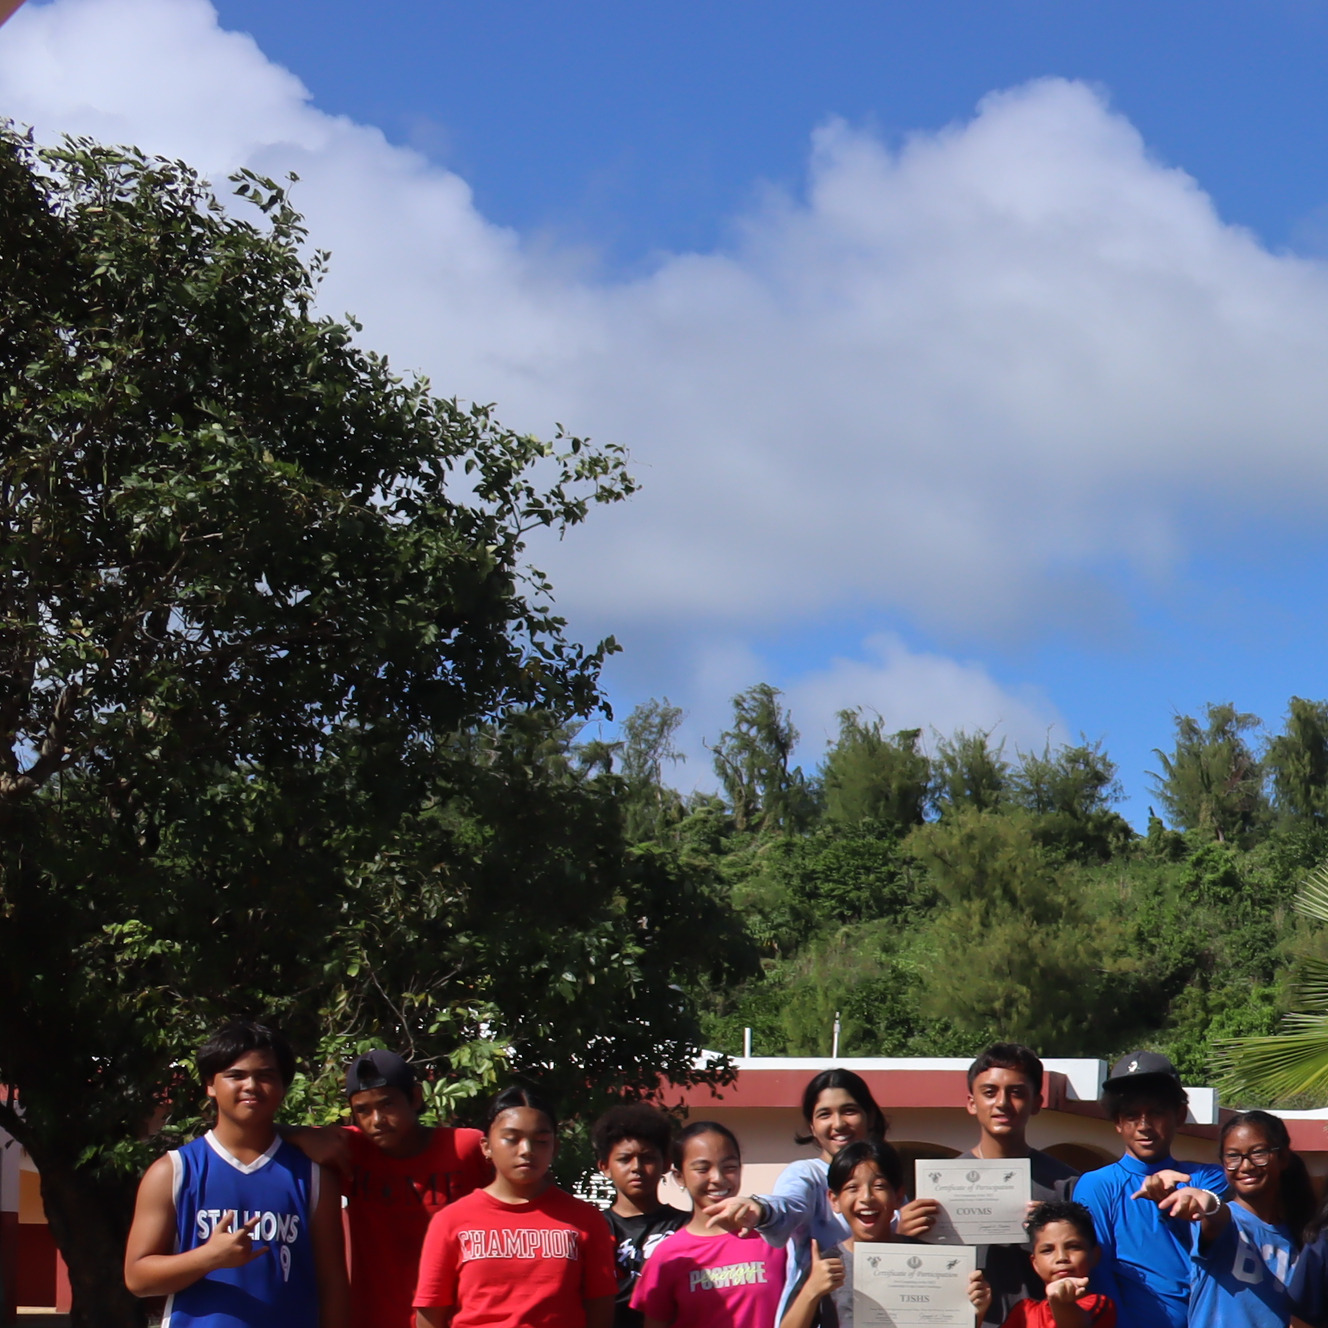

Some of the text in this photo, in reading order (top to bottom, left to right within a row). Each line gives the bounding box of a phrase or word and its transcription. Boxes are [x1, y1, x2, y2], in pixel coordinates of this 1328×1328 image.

[956, 1207, 992, 1216] COVMS
[457, 1228, 579, 1262] CHAMPION
[280, 1246, 291, 1282] 9
[899, 1294, 931, 1303] TJSHS
